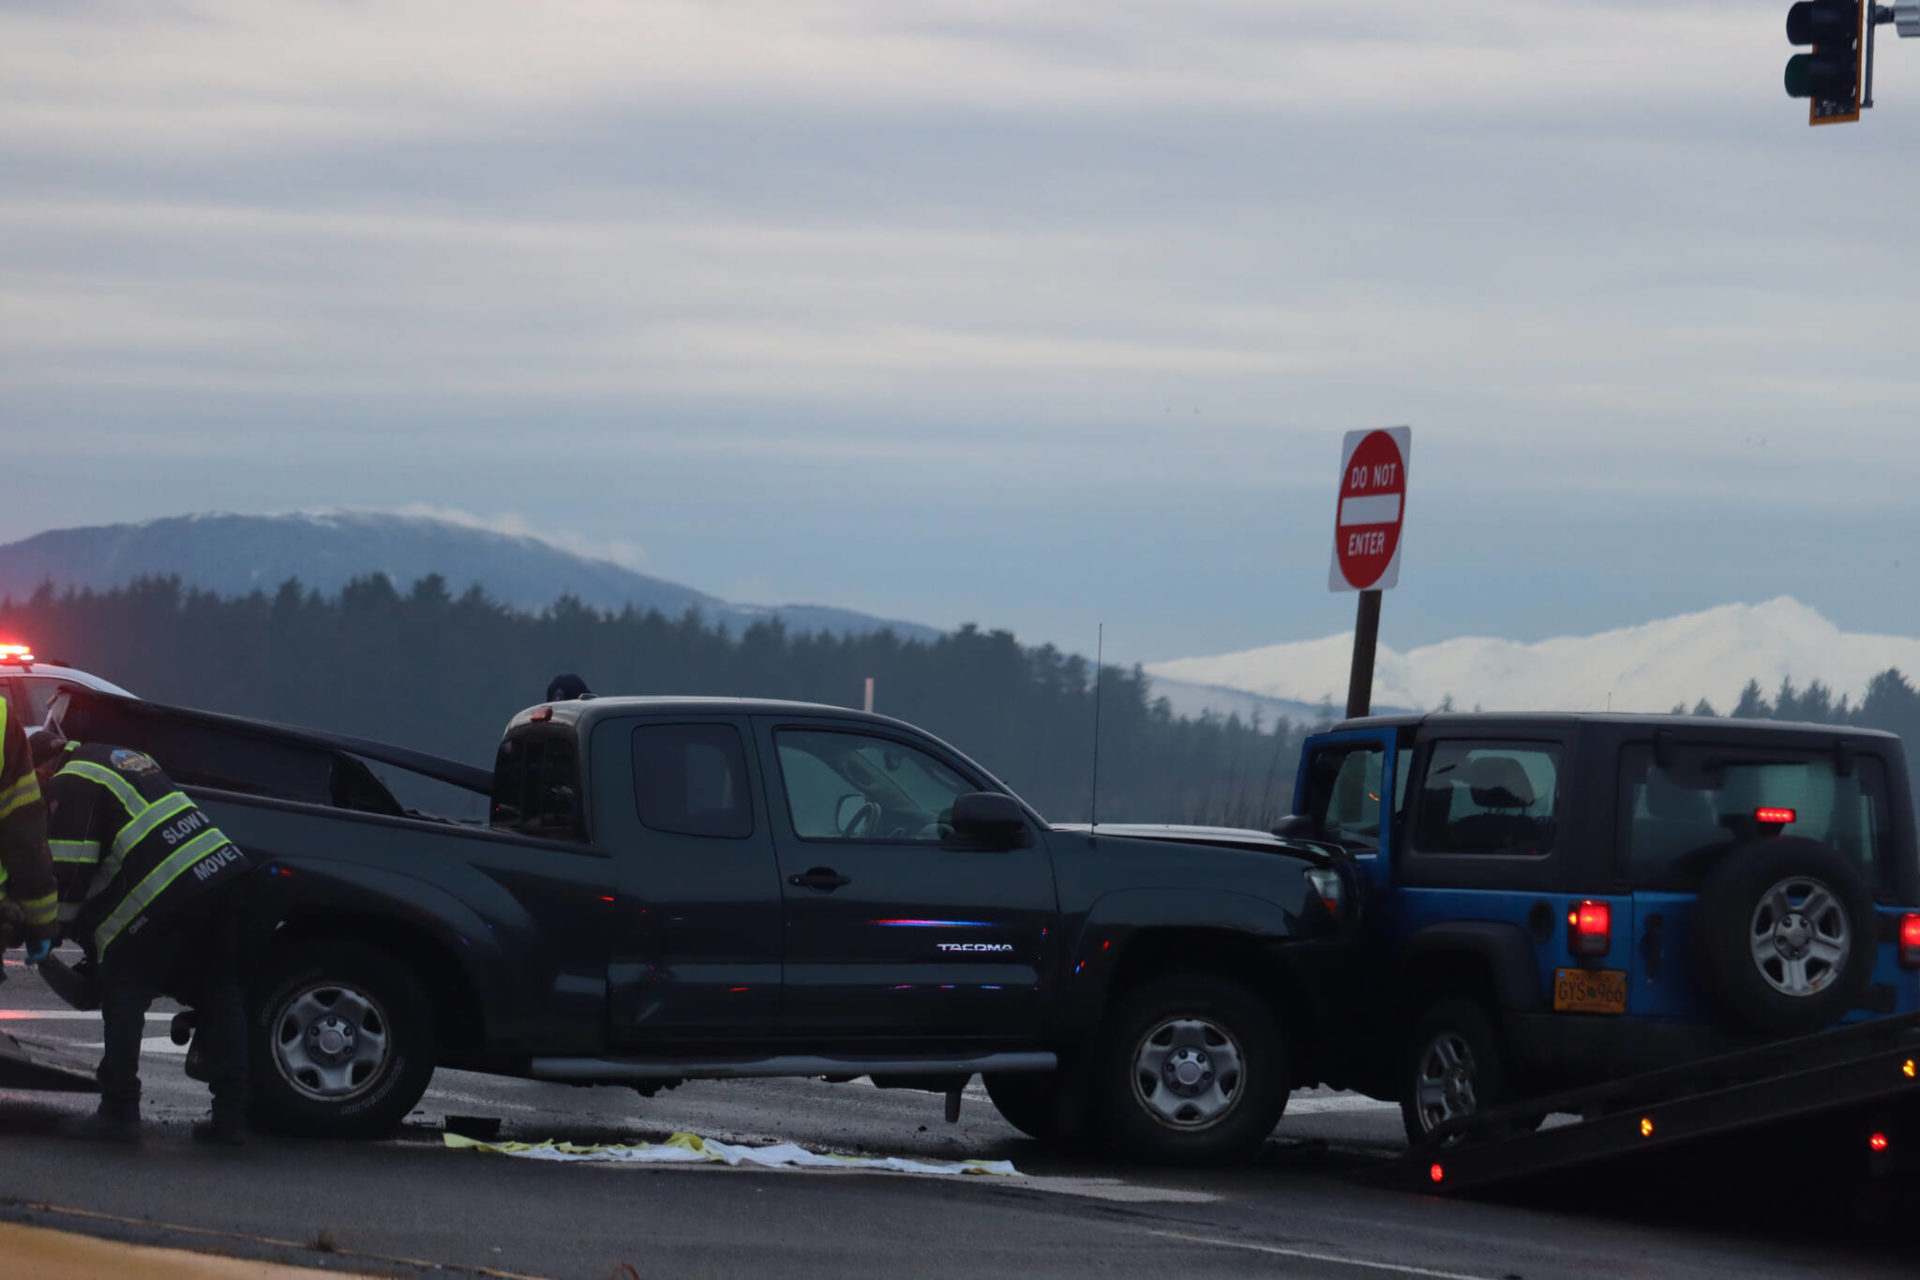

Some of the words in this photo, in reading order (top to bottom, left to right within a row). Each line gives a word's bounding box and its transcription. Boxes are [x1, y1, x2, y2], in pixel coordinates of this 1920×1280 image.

[1351, 466, 1368, 488] DO
[1373, 463, 1396, 486] NOT
[1348, 531, 1385, 556] ENTER
[162, 813, 201, 844] SLOW
[193, 846, 237, 880] MOVE
[936, 943, 1013, 951] TACOMA
[1559, 980, 1586, 1001] GYS
